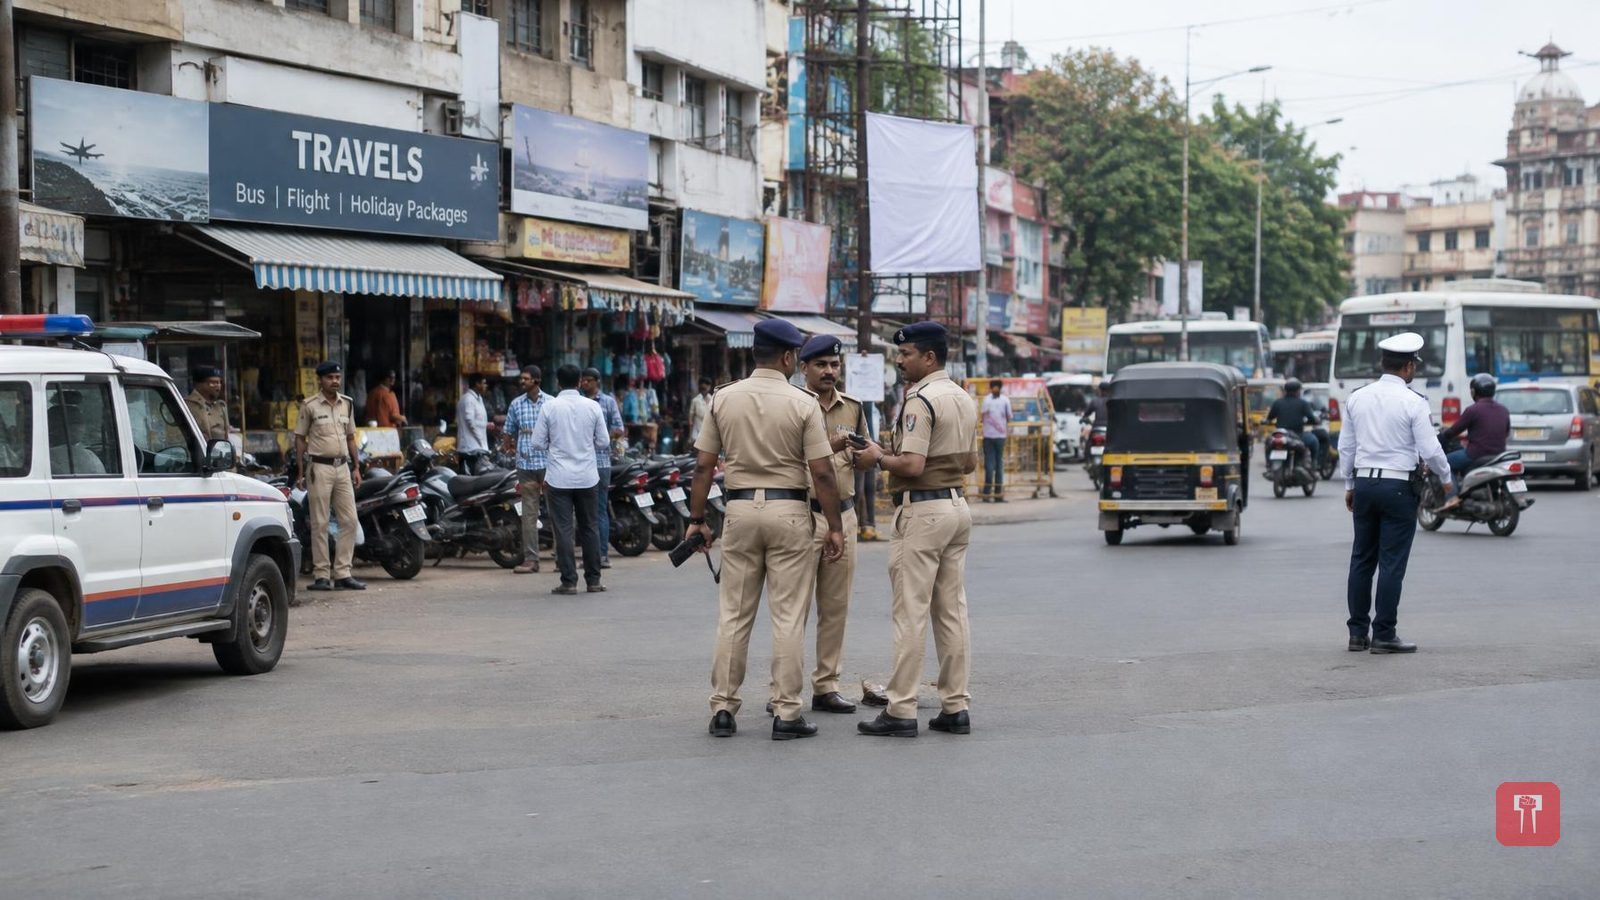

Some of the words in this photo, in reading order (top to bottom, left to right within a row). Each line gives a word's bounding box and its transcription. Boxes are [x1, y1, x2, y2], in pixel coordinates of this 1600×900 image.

[291, 129, 424, 183] TRAVELS
[235, 181, 266, 205] Bus
[287, 187, 331, 215] Flight
[350, 194, 404, 222] Holiday
[407, 199, 468, 227] Packages
